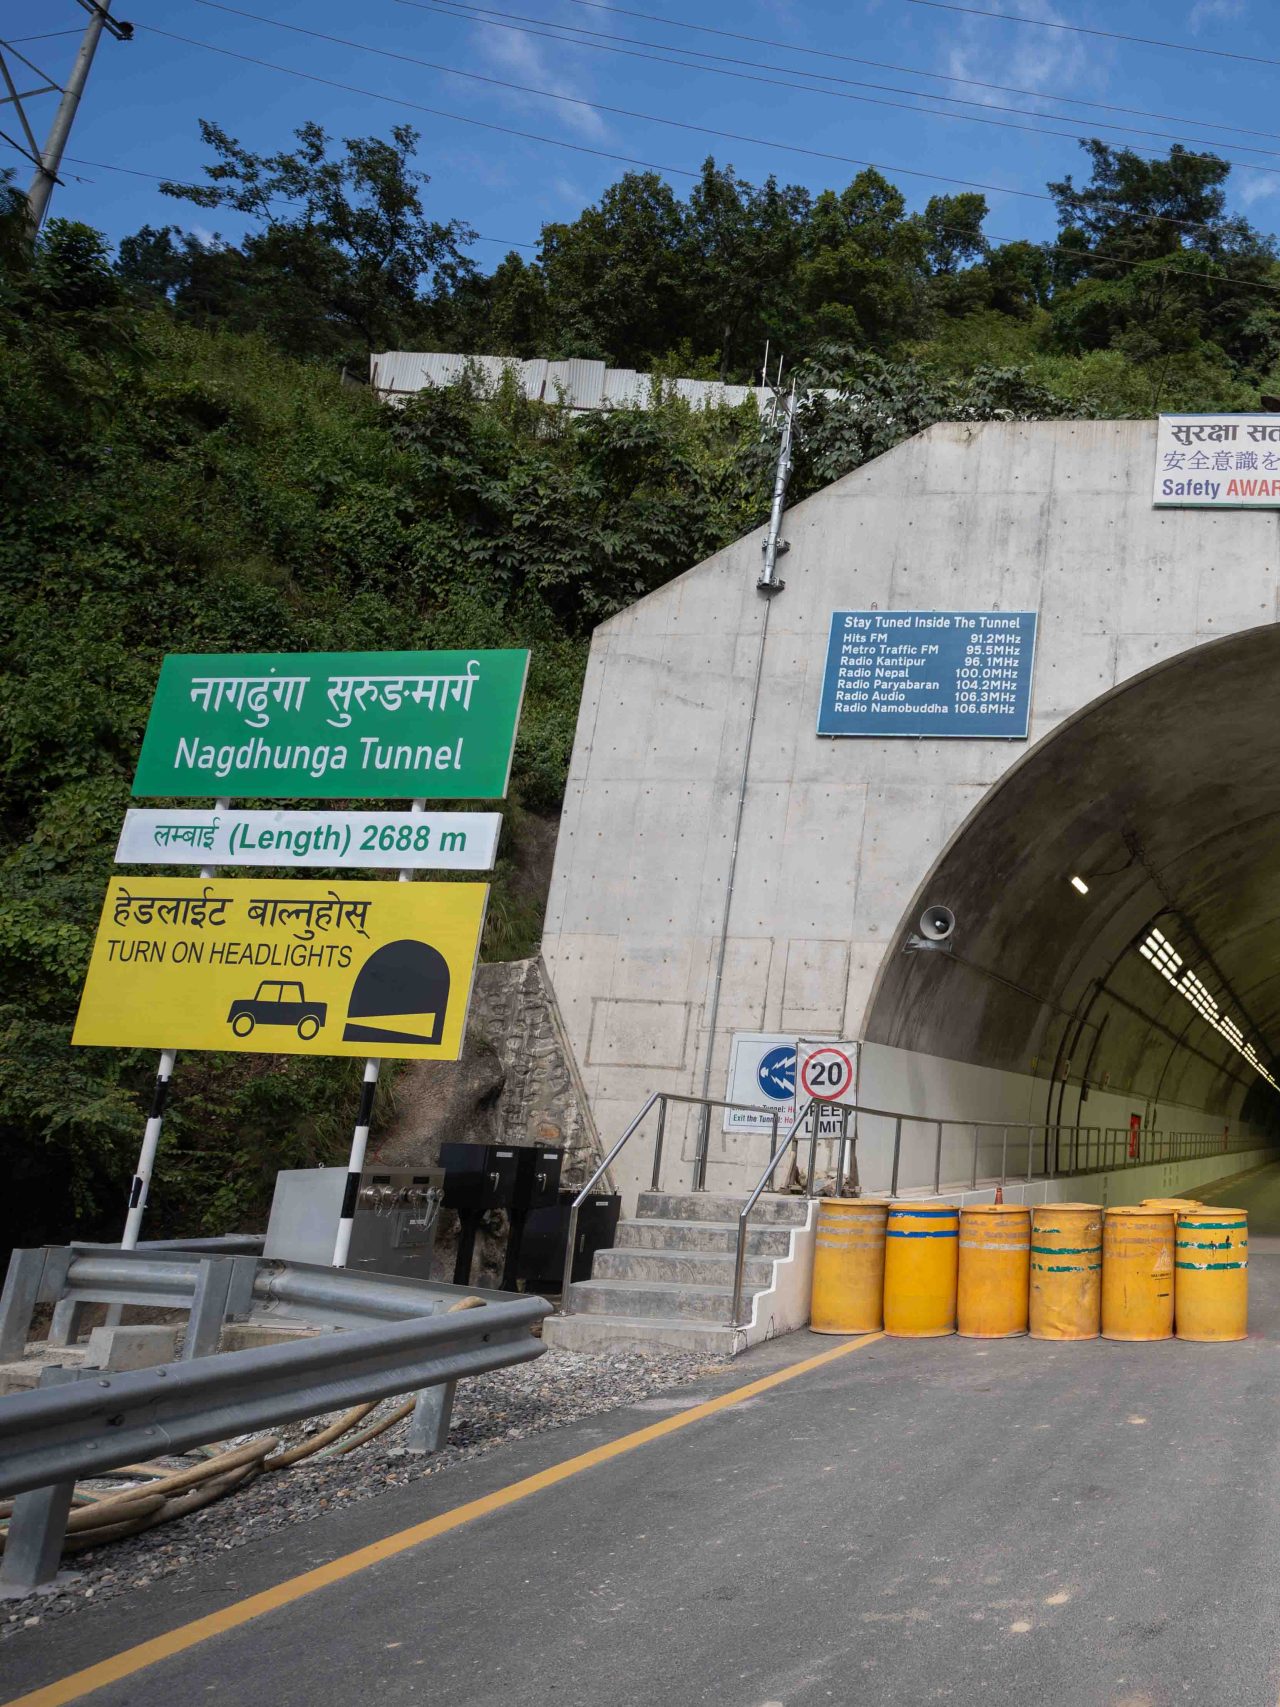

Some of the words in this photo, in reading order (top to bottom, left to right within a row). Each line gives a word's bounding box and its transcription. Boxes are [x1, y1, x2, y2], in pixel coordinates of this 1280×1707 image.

[1171, 425, 1239, 445] सुरक्षा
[1162, 479, 1220, 499] Safety
[844, 616, 871, 630] Stay
[876, 617, 911, 628] Tuned
[915, 617, 950, 628] Inside
[954, 617, 975, 628] The
[980, 617, 1020, 629] Tunnel
[844, 634, 866, 642] Hits
[870, 634, 887, 642] FM
[971, 634, 1021, 644] 91.2MHz
[842, 645, 875, 654] Metro
[880, 645, 917, 654] Traffic
[921, 646, 939, 654] FM
[966, 646, 1020, 655] 95.5MHz
[841, 657, 873, 666] Radio
[877, 657, 926, 668] Kantipur
[839, 669, 871, 677] Radio
[875, 669, 909, 680] Nepal
[956, 669, 1018, 678] 100.0MHz
[838, 680, 869, 689] Radio
[874, 680, 939, 691] Paryabaran
[956, 681, 1017, 690] 104.2MHz
[190, 667, 310, 727] नागढुंगा
[327, 660, 480, 727] सुरुङमार्ग
[836, 692, 868, 701] Radio
[872, 692, 905, 701] Audio
[955, 692, 1015, 702] 106.3MHz
[835, 704, 867, 712] Radio
[871, 704, 948, 713] Namobuddha
[954, 704, 1015, 714] 106.6MHz
[174, 737, 347, 777] Nagdhunga
[360, 737, 463, 770] Tunnel
[153, 817, 220, 848] लम्बाई
[229, 823, 351, 857] (Length)
[360, 826, 429, 851] 2688
[439, 831, 466, 852] m
[114, 887, 234, 928] हेडलाईट
[248, 890, 372, 940] बाल्नुहोस्
[107, 940, 165, 963] TURN
[172, 942, 204, 964] ON
[209, 943, 352, 968] HEADLIGHTS
[810, 1061, 843, 1086] 20
[733, 1113, 746, 1121] Exit
[747, 1114, 757, 1122] the
[759, 1115, 783, 1123] Tunnl:
[805, 1121, 844, 1133] LMIT
